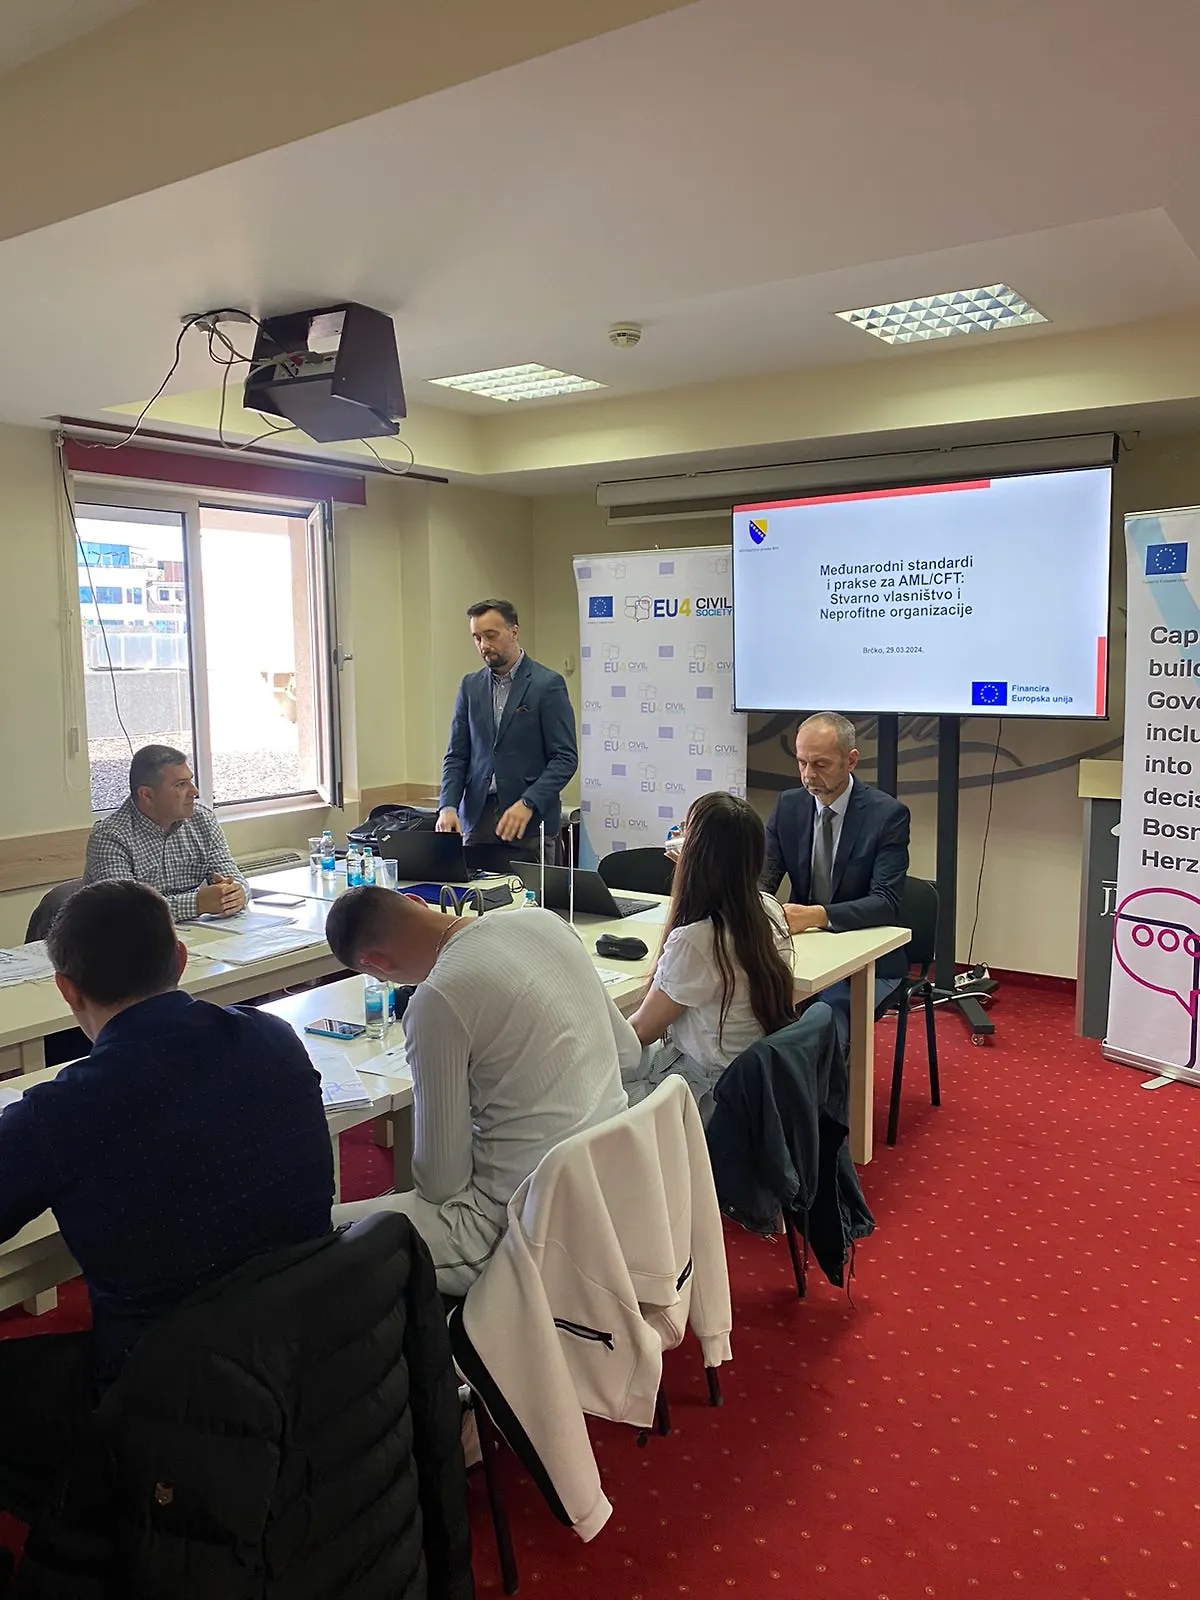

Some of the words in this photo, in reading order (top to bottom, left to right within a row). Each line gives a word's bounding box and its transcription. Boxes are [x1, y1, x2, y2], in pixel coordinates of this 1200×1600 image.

[820, 560, 904, 577] Međunarodni
[908, 555, 974, 571] standardi
[827, 579, 831, 590] i
[834, 577, 877, 592] prakse
[880, 578, 895, 588] za
[898, 572, 965, 587] AML/CFT:
[830, 593, 880, 605] Stvarno
[883, 588, 953, 603] vlasništvo
[957, 588, 962, 600] i
[653, 597, 691, 618] EU4
[696, 597, 732, 609] CIVIL
[695, 608, 733, 617] SOCIETY
[820, 606, 886, 622] Neprofitne
[889, 603, 973, 620] organizacije
[1012, 684, 1050, 693] Financira
[1012, 694, 1051, 704] Europska
[1052, 695, 1074, 705] unija
[1147, 690, 1200, 710] Gov
[1144, 754, 1193, 776] into
[1141, 848, 1200, 874] Herz
